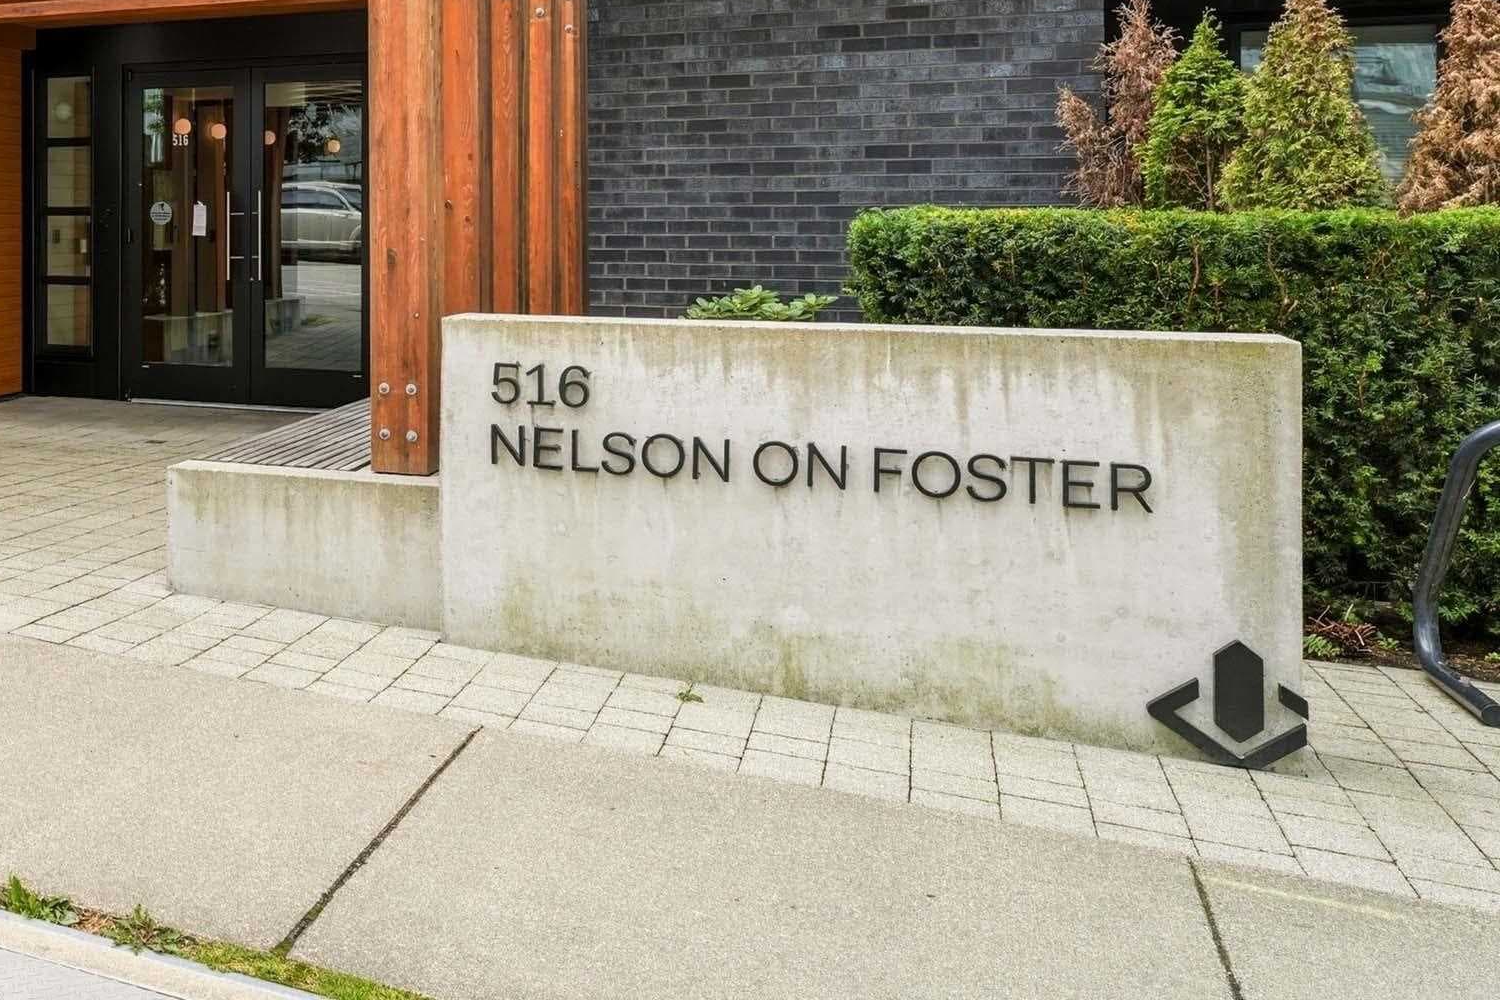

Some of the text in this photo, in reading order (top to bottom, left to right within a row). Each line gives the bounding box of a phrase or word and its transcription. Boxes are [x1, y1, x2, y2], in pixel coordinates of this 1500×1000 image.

[172, 134, 189, 146] 516
[491, 361, 592, 408] 516
[491, 423, 1154, 514] NELSON ON FOSTER
